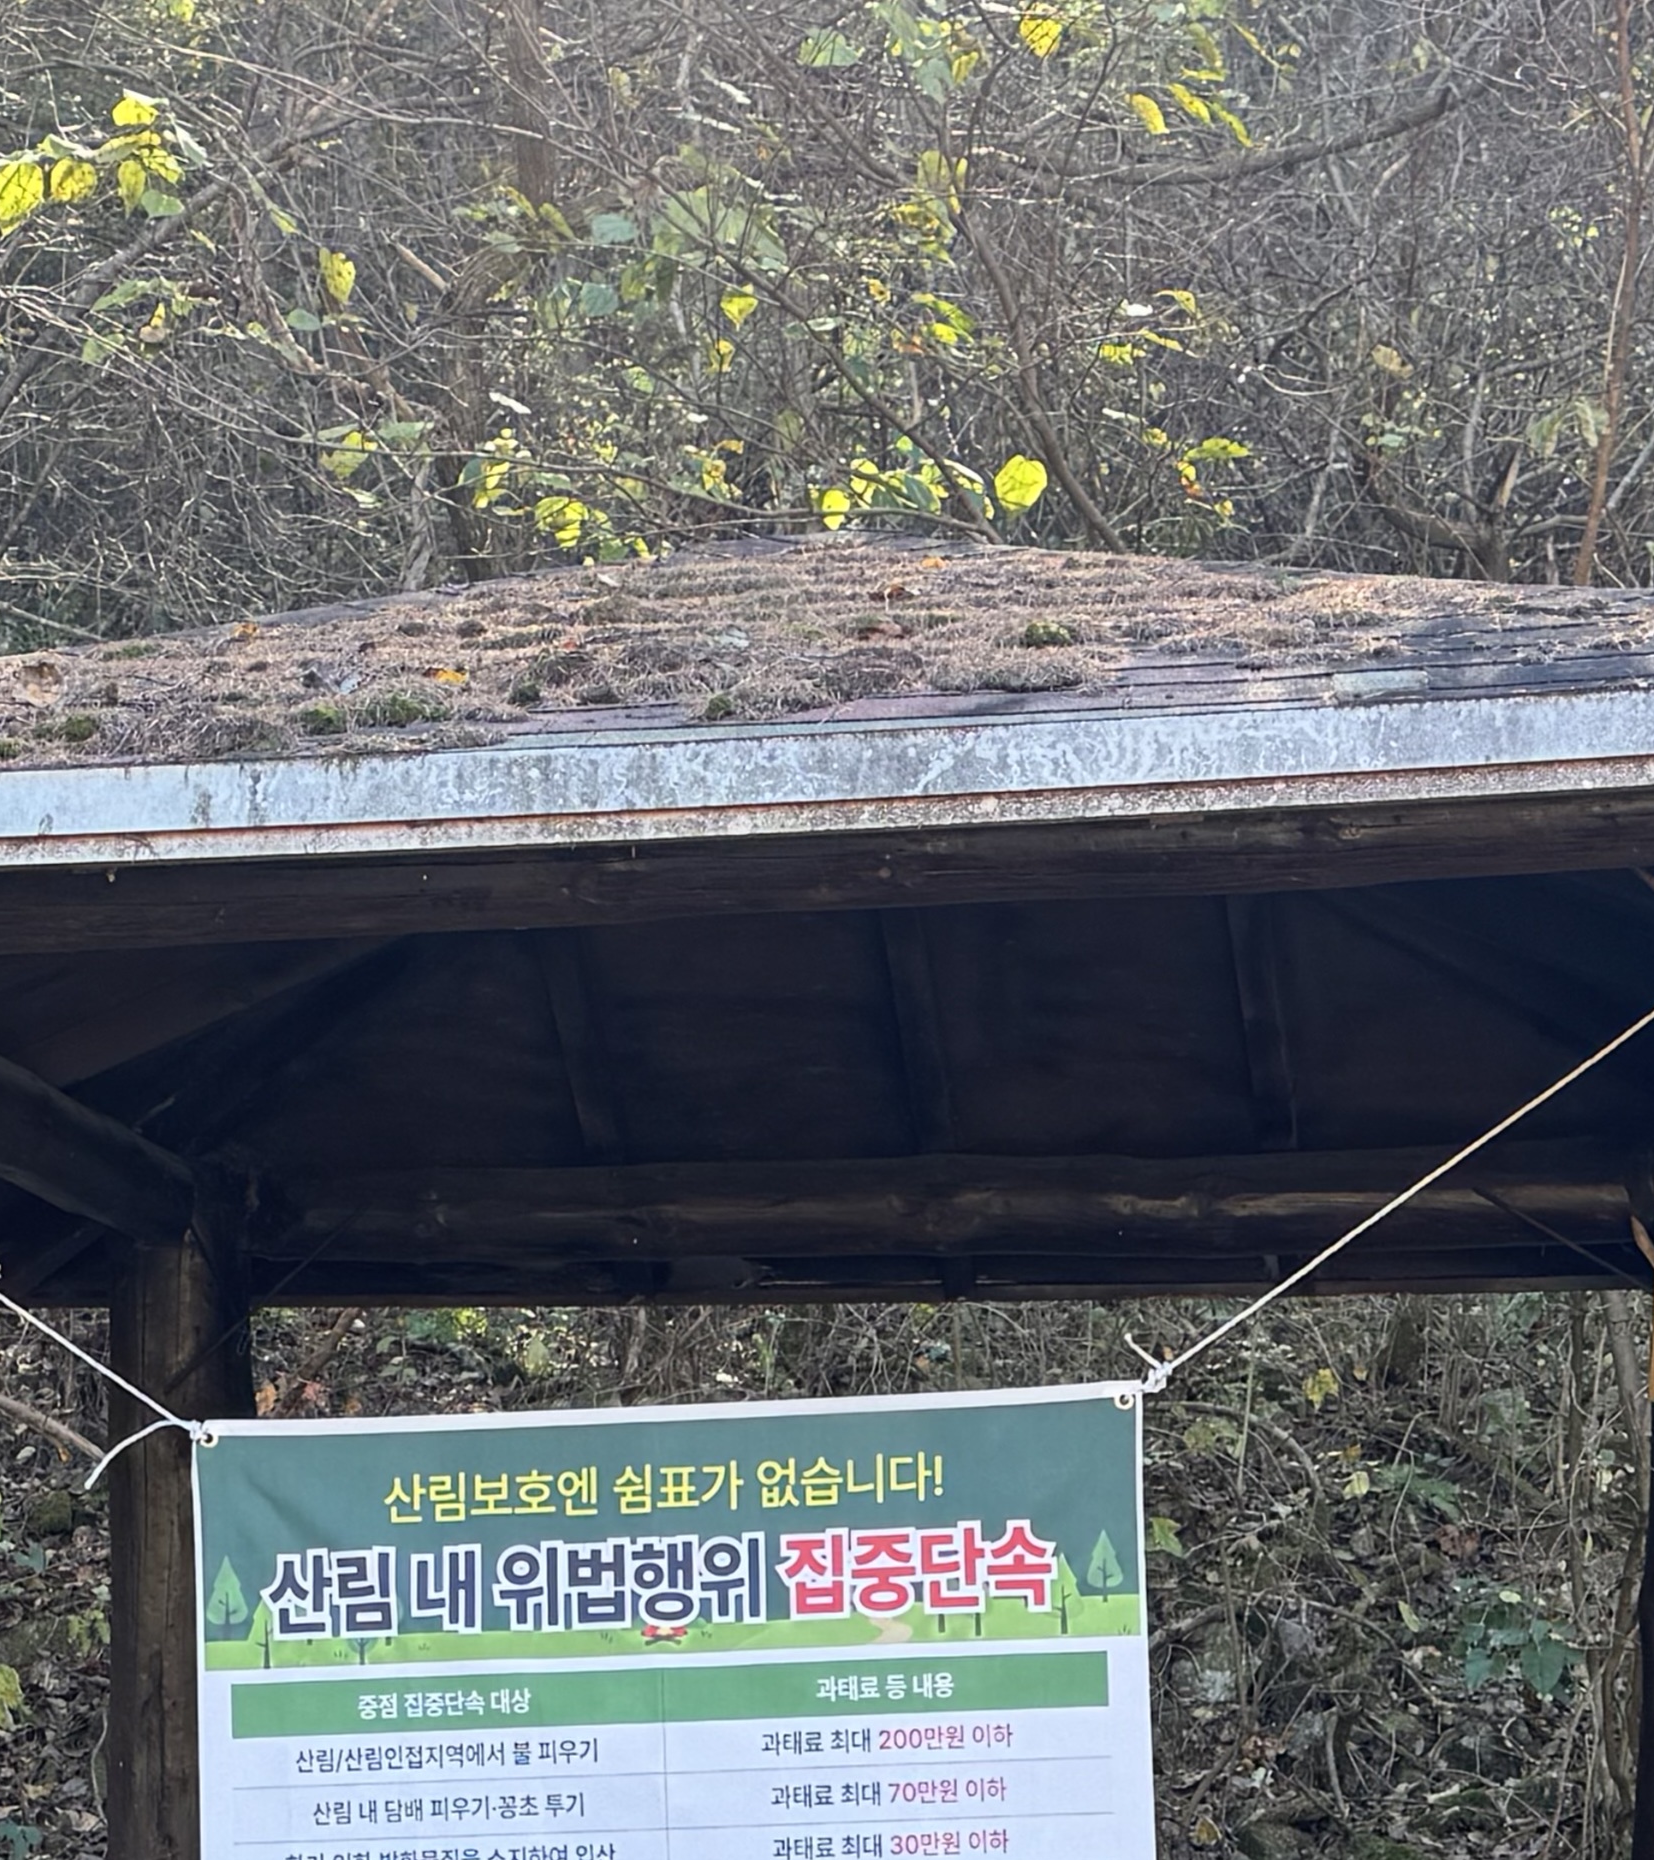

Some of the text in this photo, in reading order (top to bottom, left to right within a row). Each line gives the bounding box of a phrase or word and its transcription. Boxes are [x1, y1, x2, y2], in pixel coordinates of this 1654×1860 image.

[383, 1451, 944, 1523] 산림보호엔 쉼표가 없습니다!
[266, 1523, 1054, 1637] 산림 내 위법행위 집중단속
[816, 1673, 954, 1701] 과태료 등 내용
[357, 1688, 530, 1720] 중점 집중단속 대상
[296, 1738, 599, 1773] 산림/산림인접지역에서 불 피우기
[761, 1723, 1013, 1756] 과태료 최대 200만원 이하
[313, 1800, 352, 1826] 산림
[359, 1799, 377, 1823] 내
[383, 1799, 423, 1823] 담배
[545, 1792, 585, 1818] 투기
[771, 1777, 1007, 1809] 과태료 최대 70만원 이하
[773, 1829, 1010, 1860] 과태료 최대 30만원 이하
